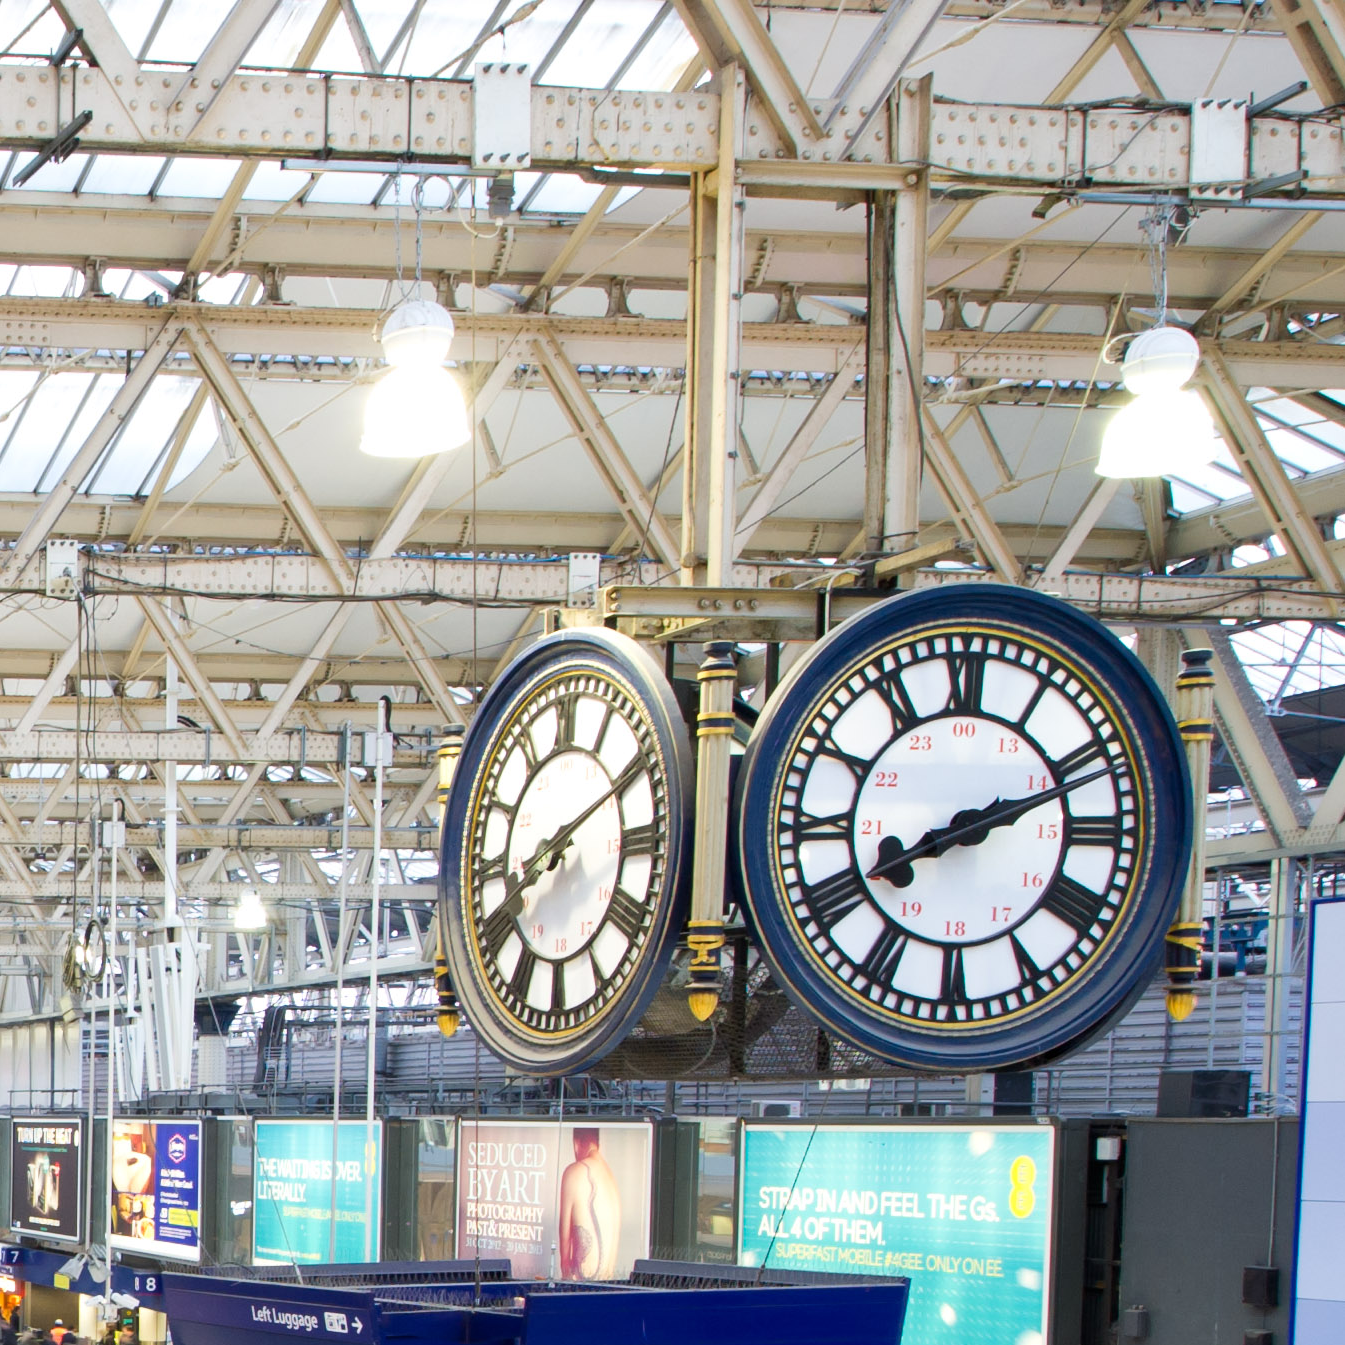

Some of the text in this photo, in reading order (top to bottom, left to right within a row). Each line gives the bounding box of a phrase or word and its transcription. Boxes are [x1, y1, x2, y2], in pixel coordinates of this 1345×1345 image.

[953, 722, 976, 738] 00
[909, 735, 932, 752] 23
[997, 737, 1019, 754] 13
[874, 772, 899, 788] 22
[1026, 774, 1049, 791] 14
[520, 812, 533, 829] 22
[861, 820, 883, 836] 21
[1036, 823, 1059, 840] 15
[606, 838, 621, 855] 15
[1021, 872, 1043, 888] 16
[598, 886, 611, 902] 16
[900, 901, 922, 917] 19
[990, 907, 1012, 923] 17
[531, 924, 545, 940] 19
[580, 921, 595, 937] 17
[943, 920, 966, 937] 18
[554, 937, 568, 953] 18
[468, 1142, 547, 1168] SEDUCED
[258, 1158, 276, 1177] THE
[277, 1159, 321, 1181] WAITING
[466, 1203, 545, 1223] PHOTOGRAPHY
[759, 1186, 1000, 1223] STRAP IN AND FEEL THE Gs.
[758, 1213, 886, 1246] ALL 4 OF THEM.
[10, 1251, 19, 1262] 7
[775, 1242, 984, 1276] SUPERFAST MOBILE ONLY ON
[146, 1277, 156, 1291] 8
[251, 1305, 318, 1331] Left Luggage
